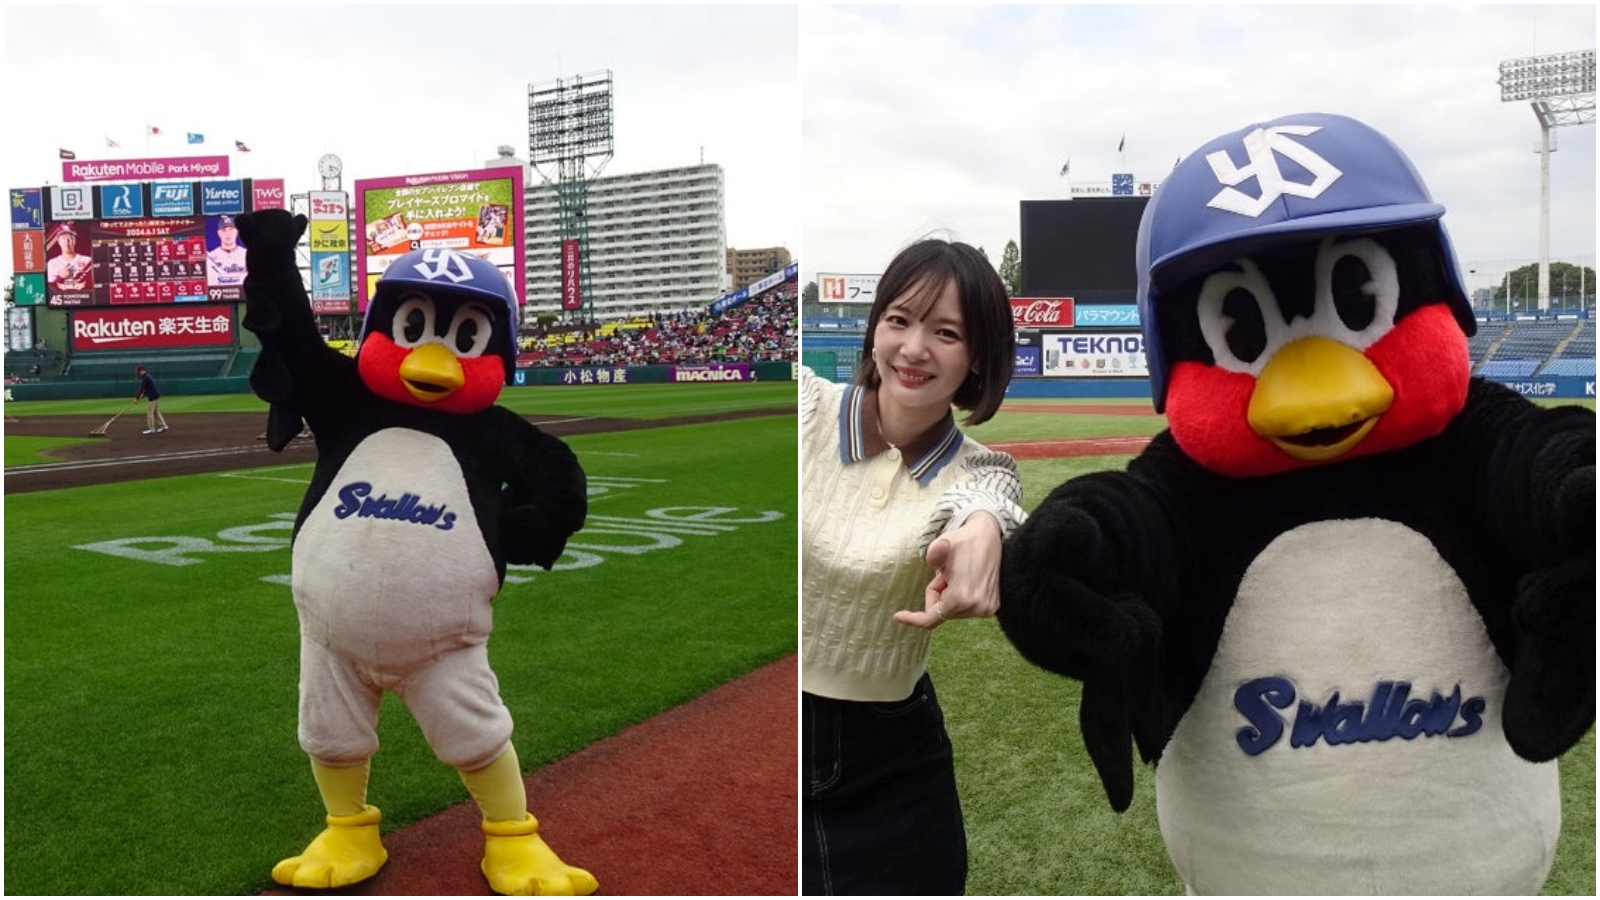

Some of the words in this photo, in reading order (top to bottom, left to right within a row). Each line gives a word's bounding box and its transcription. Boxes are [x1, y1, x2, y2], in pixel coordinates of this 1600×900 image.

[72, 163, 125, 178] Rakuten
[126, 161, 165, 176] Mobile
[168, 164, 189, 174] Park
[190, 162, 220, 175] Miyagi
[205, 187, 240, 200] Yurtec
[254, 188, 283, 199] TWG
[566, 245, 576, 304] 三井のリハウス
[50, 293, 63, 305] 45
[209, 288, 222, 300] 99
[848, 286, 877, 299] フー
[1012, 299, 1062, 324] a-Cola
[74, 318, 156, 341] Rakuten
[158, 315, 230, 335] 楽天生命
[564, 368, 627, 384] 小松物産
[334, 481, 457, 530] Swallows
[1234, 676, 1486, 756] Swallows
